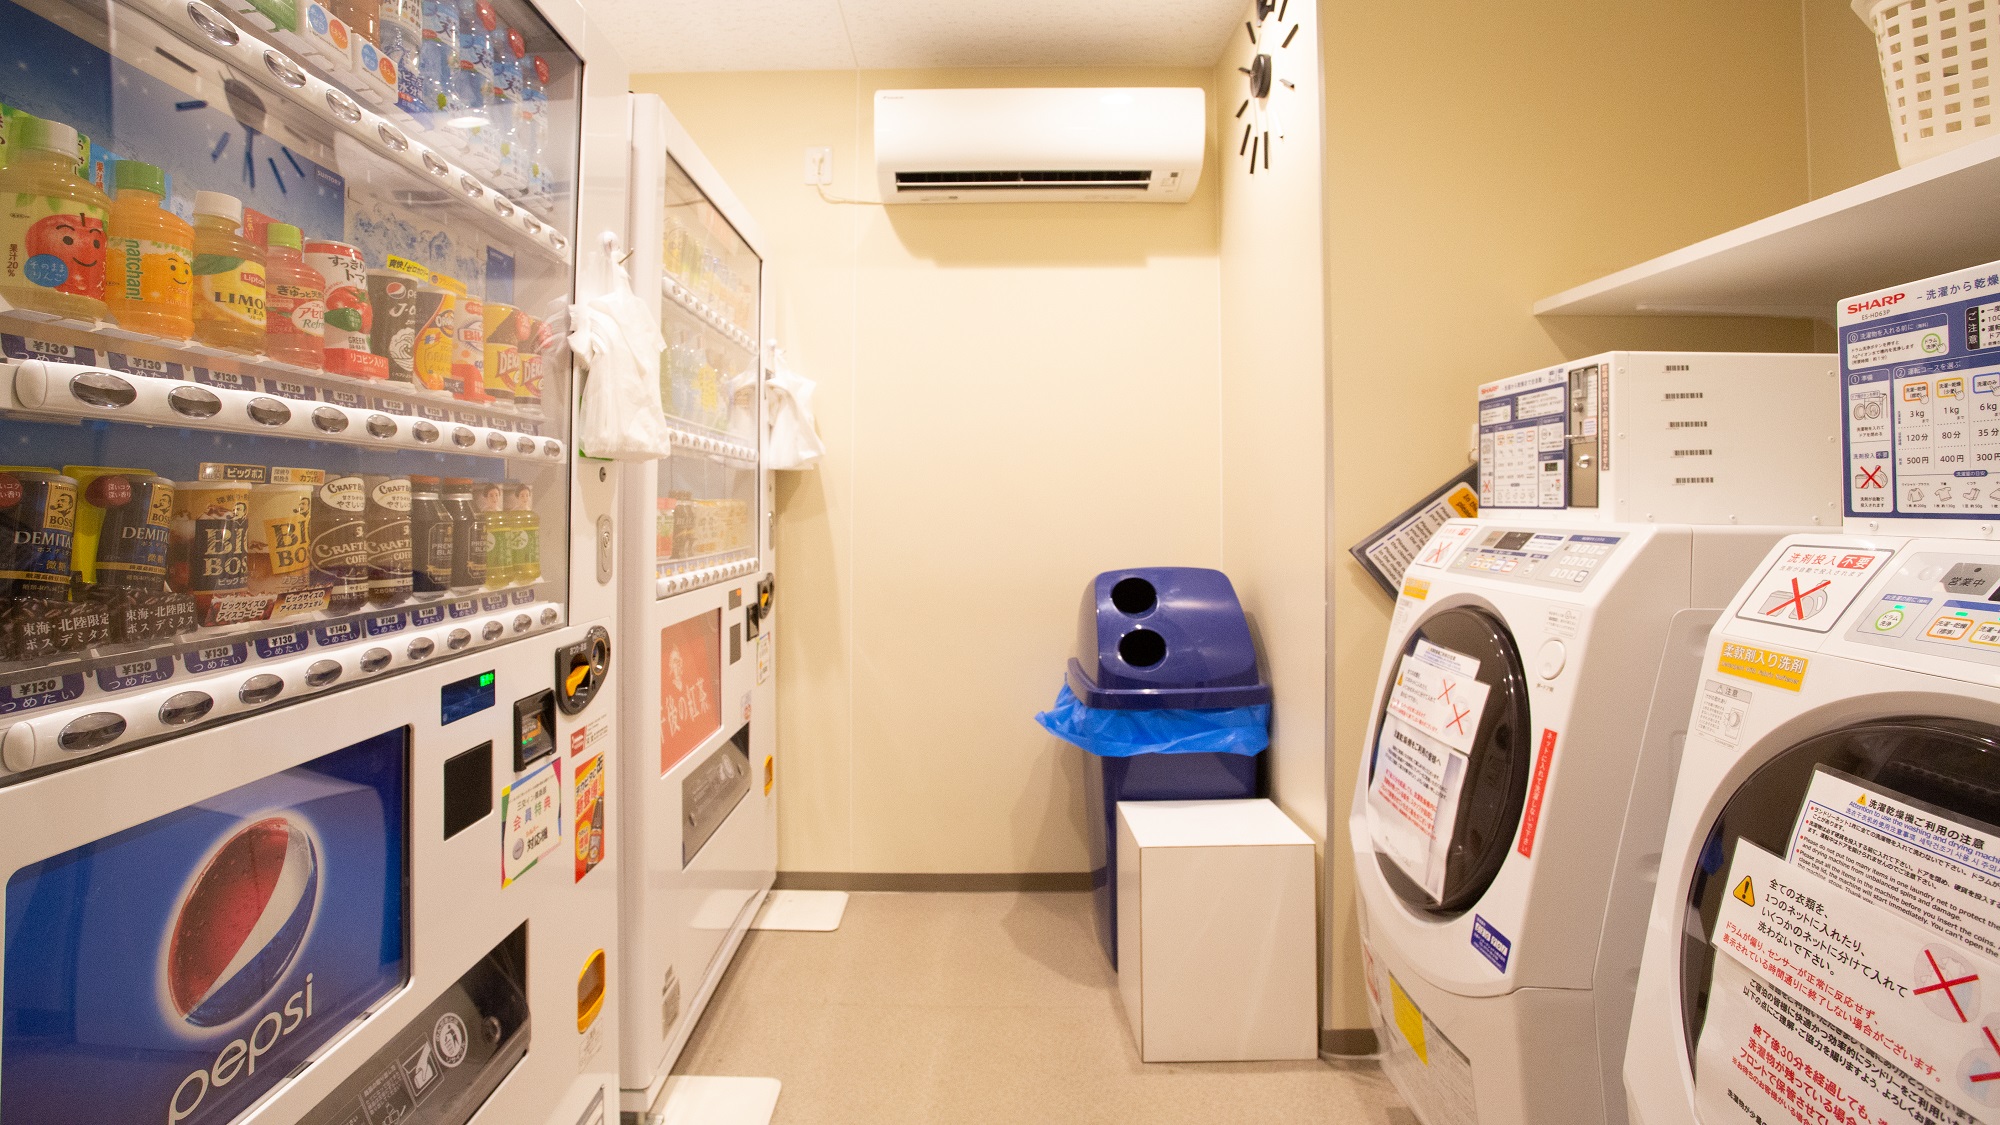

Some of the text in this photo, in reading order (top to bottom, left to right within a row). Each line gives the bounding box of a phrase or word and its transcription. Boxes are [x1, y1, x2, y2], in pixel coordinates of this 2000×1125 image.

[124, 239, 144, 301] natchan!
[214, 291, 266, 309] LIMO
[1847, 292, 1906, 315] SHARP
[32, 340, 69, 356] ¥130
[132, 357, 162, 371] ¥130
[213, 371, 238, 383] ¥130
[280, 382, 302, 393] ¥130
[1852, 452, 1876, 460] 洗剤投入
[1906, 456, 1929, 465] 500円
[1939, 454, 1965, 463] 400円
[226, 467, 264, 480] ビッグボス
[327, 483, 357, 494] CRAFT
[379, 483, 404, 494] CRAFT
[49, 515, 73, 528] BOSS
[1786, 552, 1873, 570] 洗剤投入 不要
[1948, 576, 1986, 587] 営業中
[221, 600, 267, 610] ビッグサイズの
[285, 592, 325, 604] ビッグサイズの
[126, 601, 195, 622] 東海・北陸限定
[218, 609, 264, 621] アイスコーヒー
[23, 612, 110, 636] 東海・北陸限定
[329, 624, 348, 635] ¥140
[371, 624, 404, 635] つめたい
[271, 634, 293, 646] ¥130
[321, 632, 357, 645] つめたい
[204, 646, 229, 659] ¥130
[263, 642, 304, 657] つめたい
[194, 654, 242, 672] つめたい
[1723, 643, 1805, 674] 柔軟剤入り洗剤
[121, 661, 152, 676] ¥130
[19, 679, 57, 695] ¥130
[108, 670, 168, 690] つめたい
[0, 689, 76, 712] つめたい
[1812, 813, 1845, 832] ことがあります。
[1849, 800, 1974, 855] Attention to use the washing and drying
[1868, 798, 1985, 850] 洗濯乾燥機ご利用の注意
[1802, 843, 1962, 922] and drying machine from unbalanced spins and damage.
[1803, 836, 1819, 847] Please
[1826, 847, 1836, 855] not
[1835, 851, 1845, 860] put
[1845, 855, 1855, 864] too
[1855, 860, 1871, 872] many
[1871, 867, 1889, 880] items
[1889, 875, 1896, 883] in
[1896, 880, 1909, 890] one
[1909, 883, 1936, 902] laundry
[1936, 897, 1949, 908] net
[1949, 903, 1958, 911] to
[1958, 908, 1986, 924] protect
[1987, 919, 2000, 931] the
[1768, 878, 1828, 919] 全ての衣類を、
[1798, 856, 1999, 958] close the lid, the machine will start immediately. You can't open the
[1799, 849, 1996, 949] Please put all the items in the machine before you insert the coins.
[1765, 893, 1866, 957] 1つのネットに入れたり、
[1757, 920, 1835, 976] 洗わないで下さい。
[1761, 906, 1909, 998] いくつかのネットに分けて入れて
[1722, 932, 1941, 1083] 表示されている時間通りに終了しない場合がございます。
[168, 973, 315, 1125] pepsi
